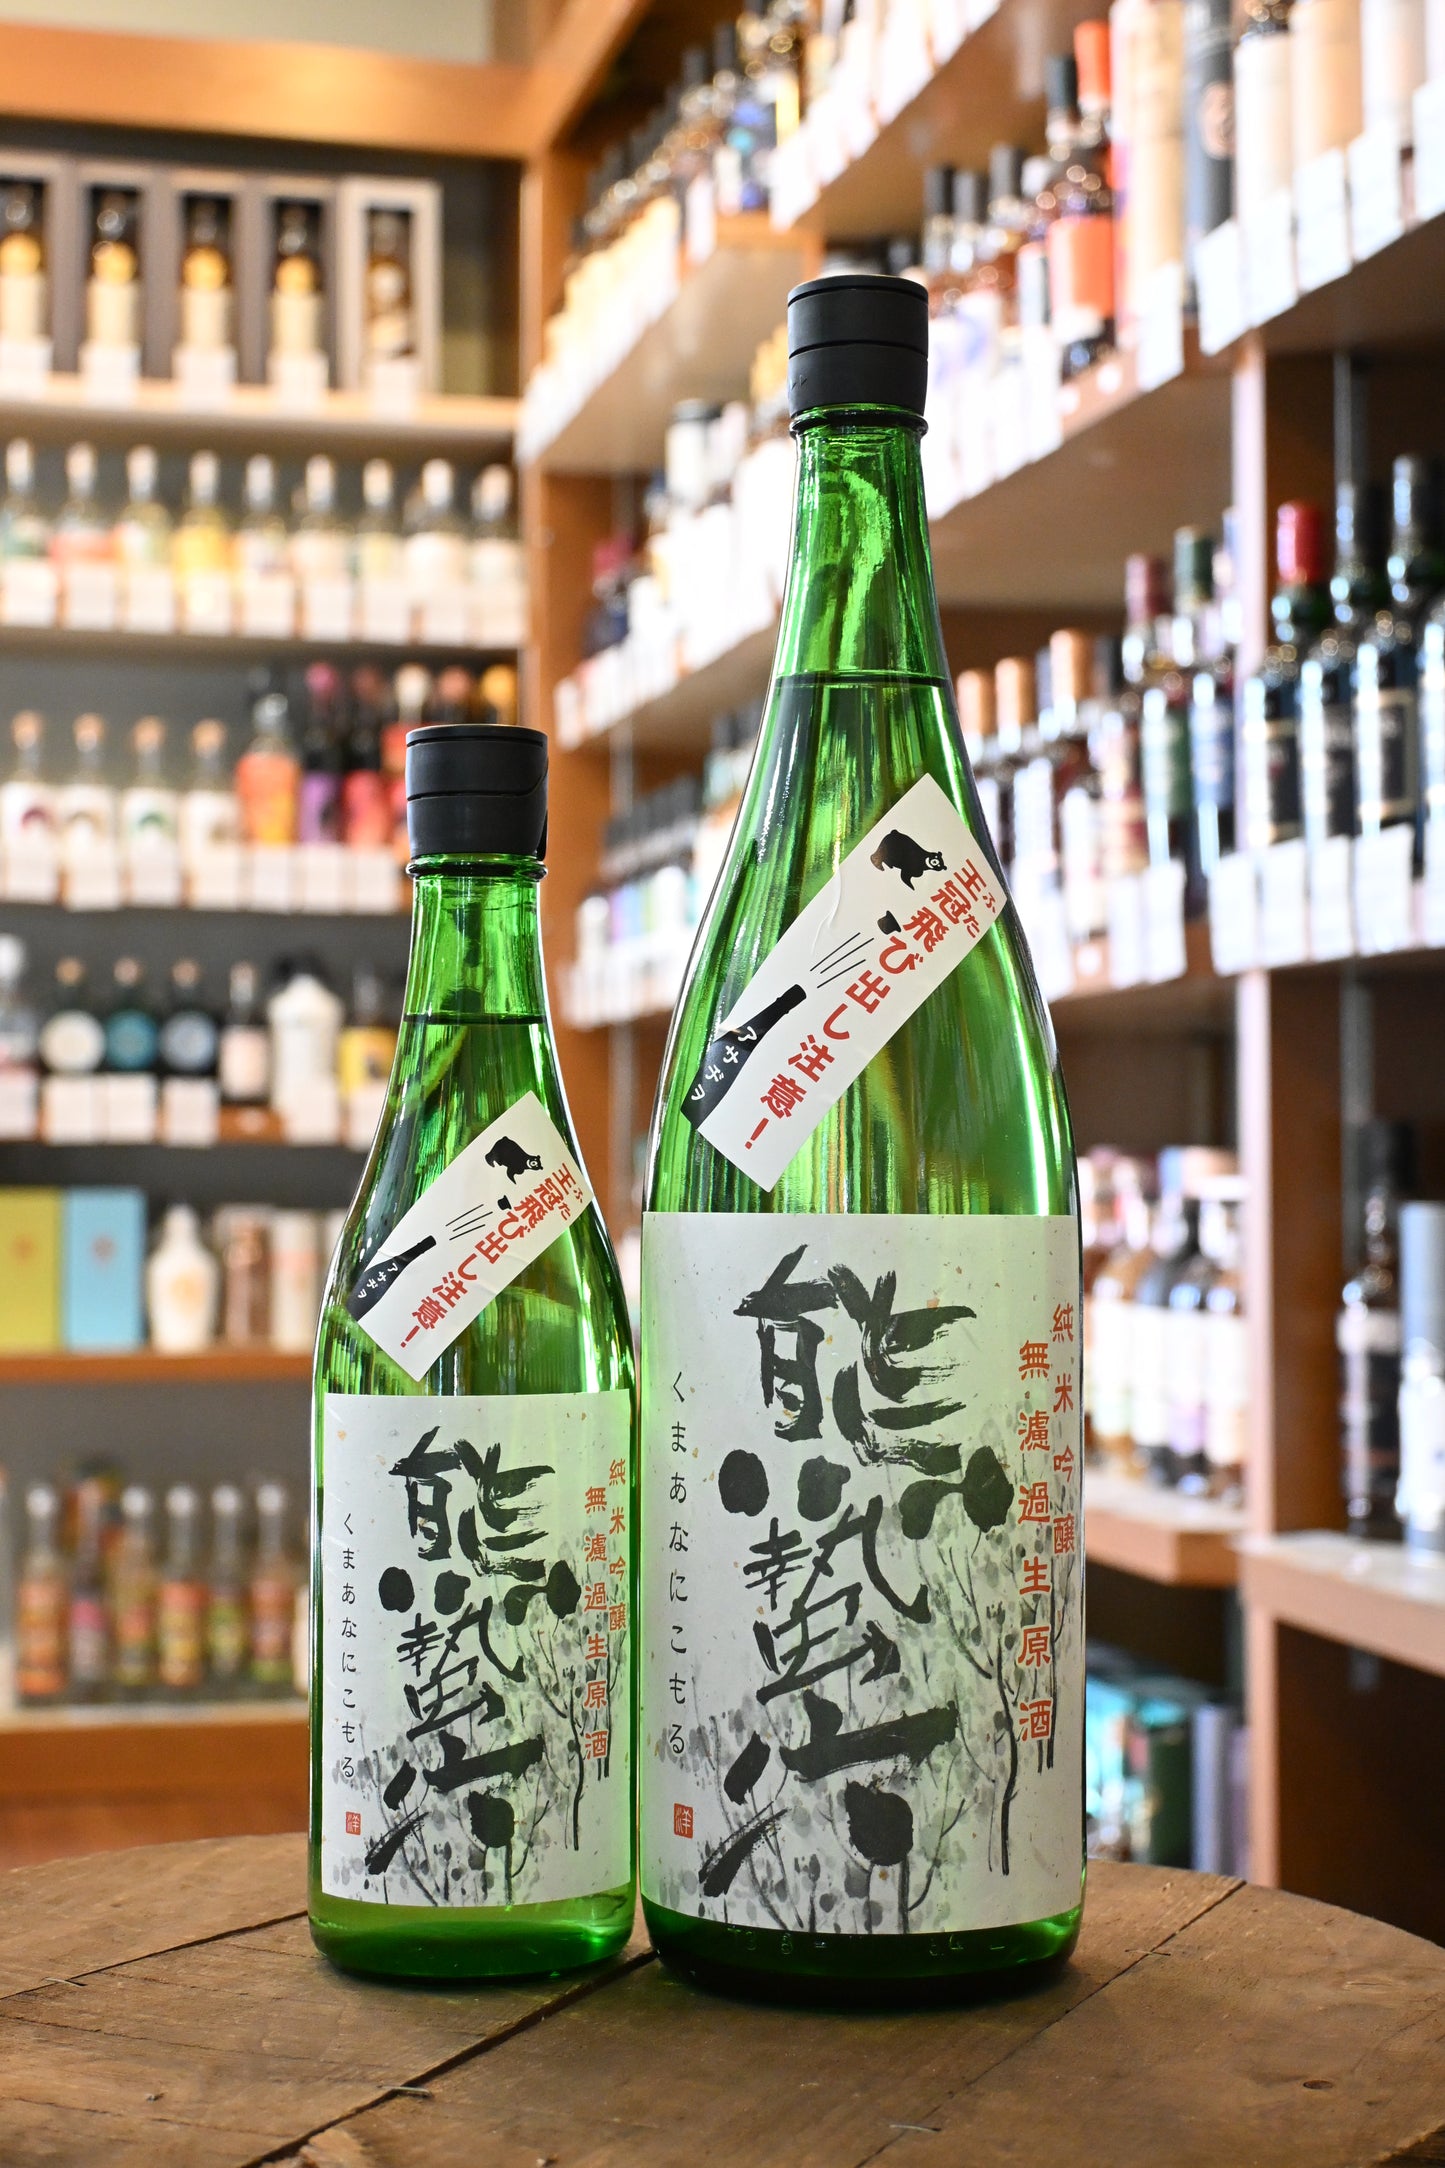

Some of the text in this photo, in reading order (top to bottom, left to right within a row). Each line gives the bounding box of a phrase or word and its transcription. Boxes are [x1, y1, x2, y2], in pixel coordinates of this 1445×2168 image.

[744, 859, 986, 1150] 王冠飛び出し注意！
[963, 893, 997, 939] ふた
[400, 1163, 576, 1348] 王冠飛び出し注意！
[608, 1458, 626, 1631] 純米吟醸
[1018, 1340, 1051, 1743] 無濾過生原酒
[1052, 1303, 1075, 1554] 純米吟醸
[341, 1513, 356, 1779] くまあなにこもる
[584, 1486, 607, 1760] 無濾過生原酒
[669, 1370, 688, 1755] くまあなにこもる
